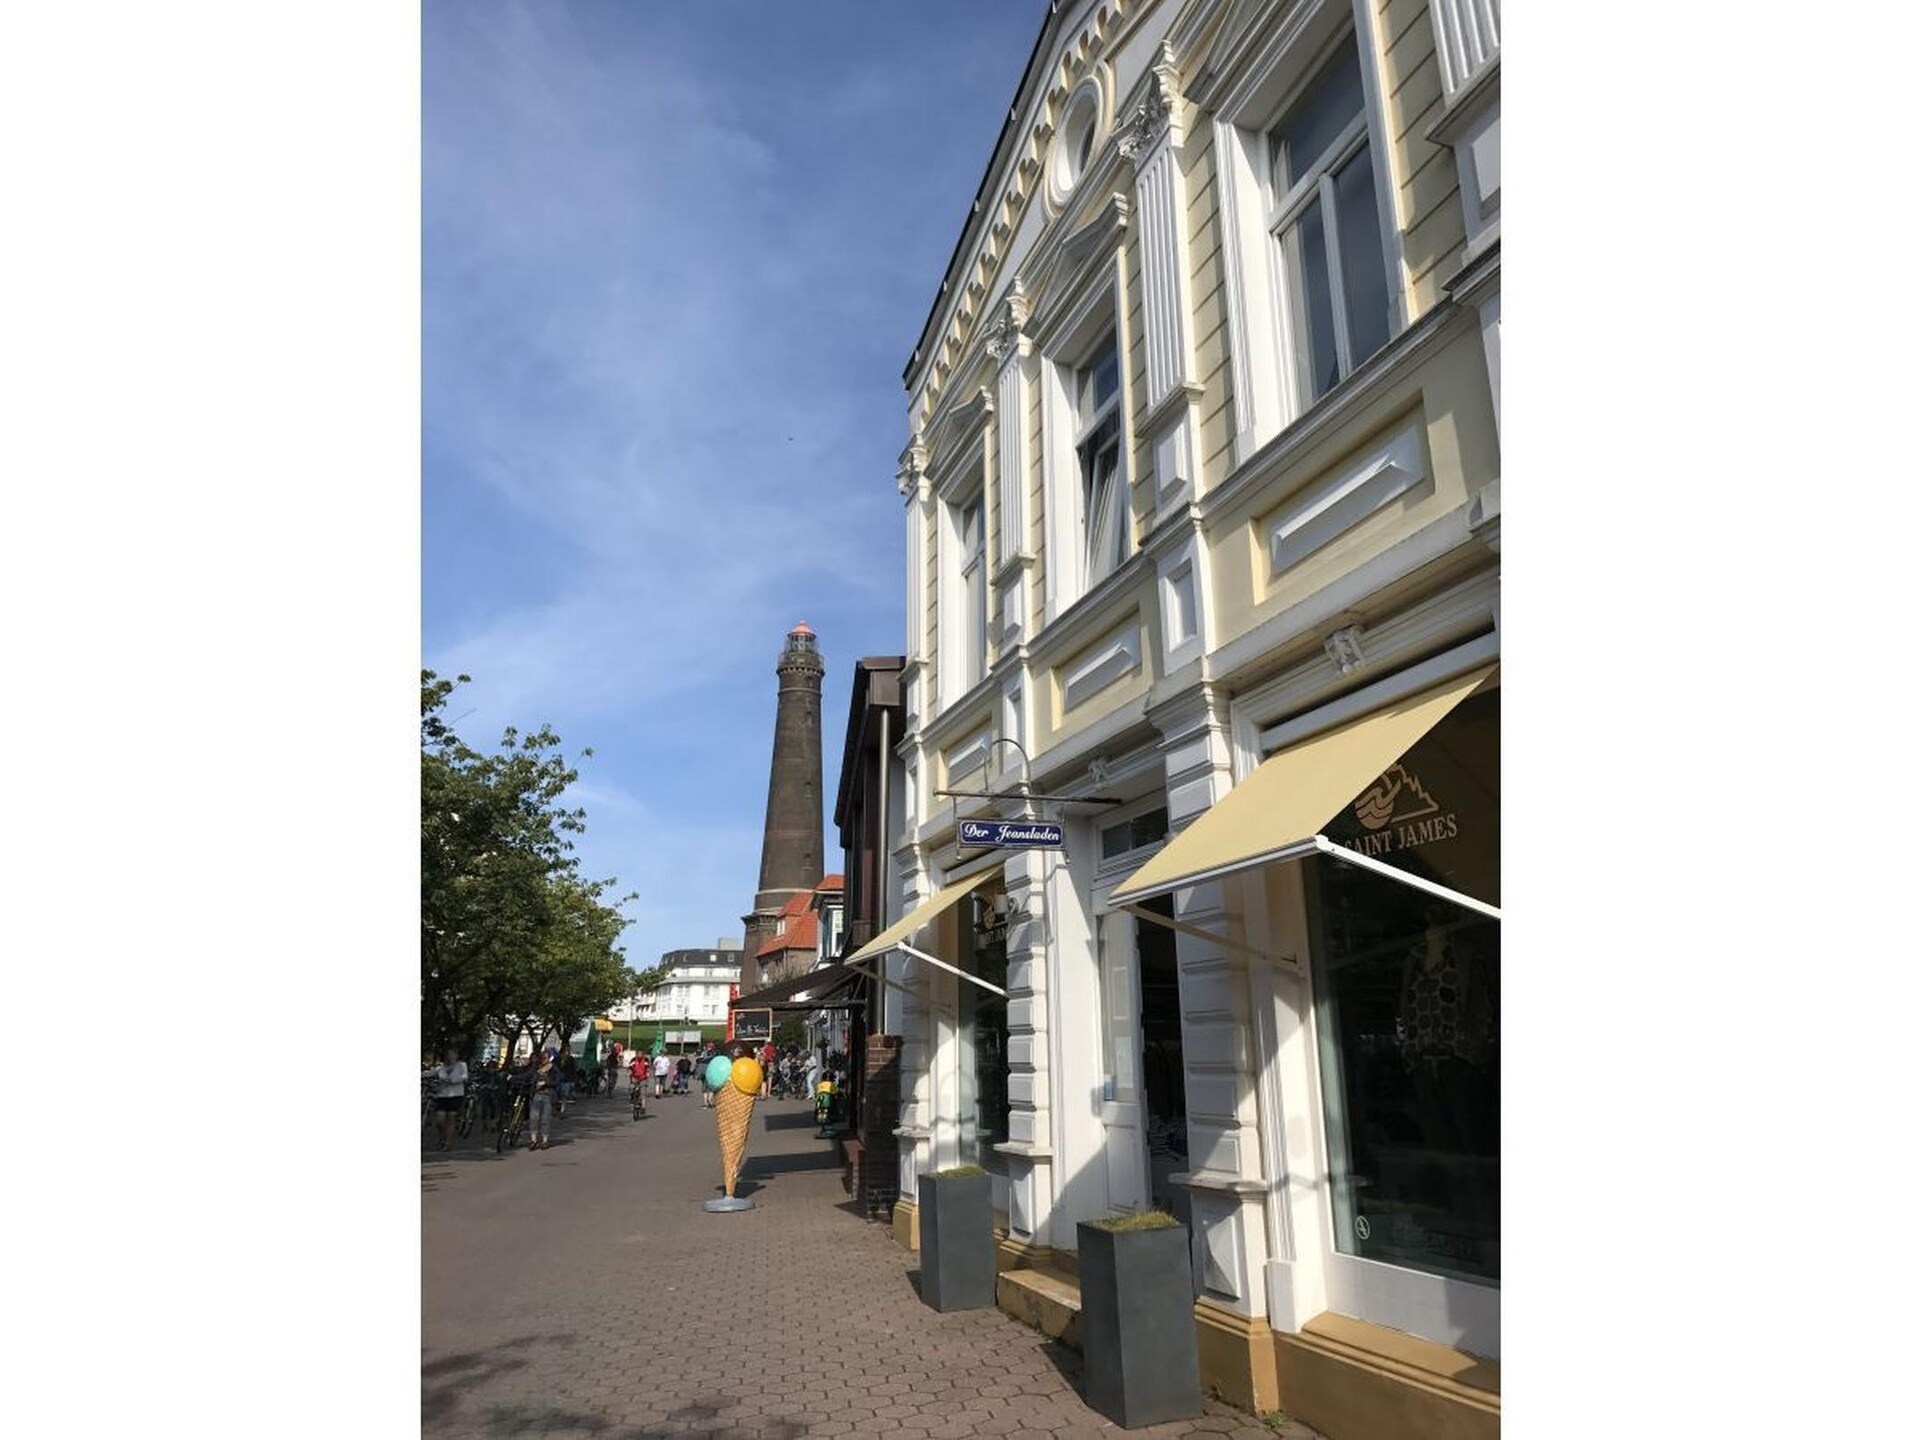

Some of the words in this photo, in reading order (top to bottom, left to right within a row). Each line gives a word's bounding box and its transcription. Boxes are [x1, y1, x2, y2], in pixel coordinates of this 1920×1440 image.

[964, 823, 989, 838] Der
[995, 825, 1060, 843] Jeansladen
[1398, 813, 1458, 850] JAMES
